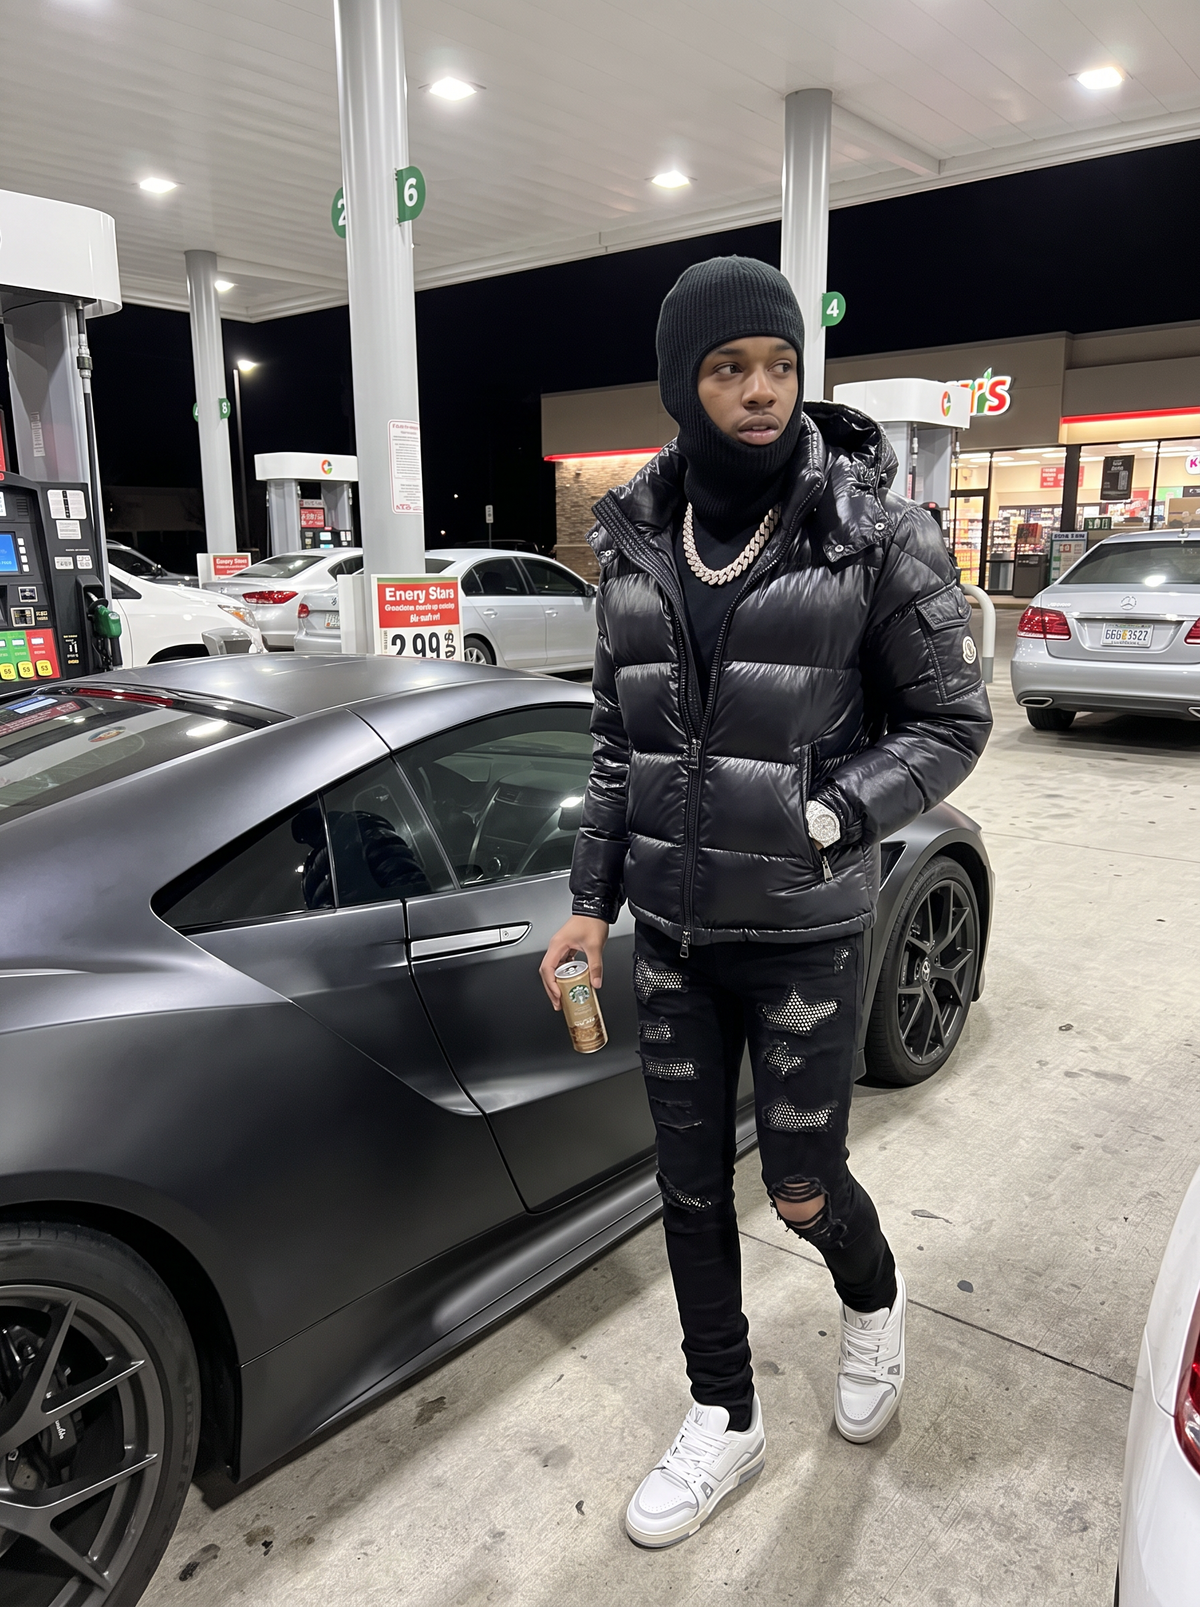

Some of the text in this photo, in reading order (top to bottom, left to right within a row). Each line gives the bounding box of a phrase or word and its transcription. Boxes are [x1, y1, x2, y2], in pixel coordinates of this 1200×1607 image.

[403, 177, 418, 207] 6
[826, 298, 840, 317] 4
[221, 401, 228, 414] 8
[385, 587, 426, 604] Enery
